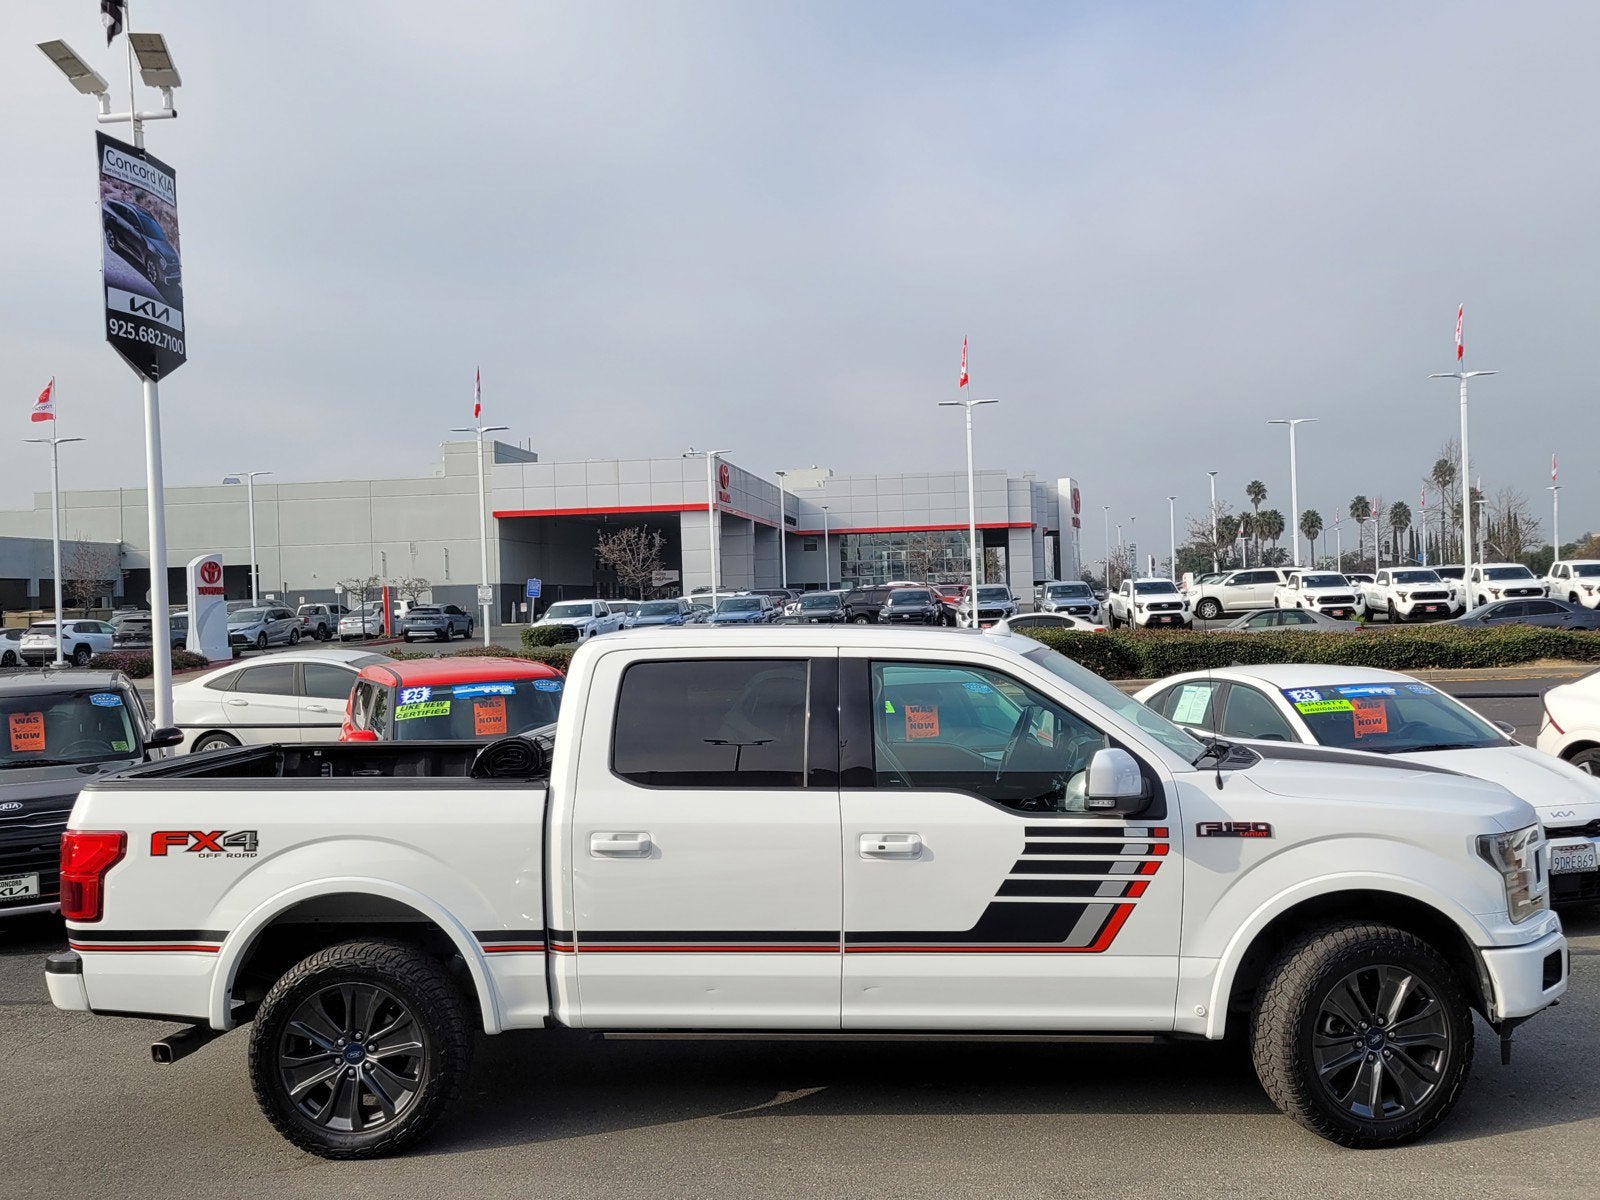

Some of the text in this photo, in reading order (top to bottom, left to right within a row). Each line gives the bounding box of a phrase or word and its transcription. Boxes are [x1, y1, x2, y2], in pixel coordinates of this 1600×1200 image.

[106, 149, 156, 184] Concord
[157, 173, 174, 196] KIA
[129, 296, 170, 323] KIA
[109, 318, 184, 355] 925.682.7100
[406, 690, 424, 701] 25
[1296, 691, 1315, 700] 23
[400, 701, 445, 712] LIKE NEW
[479, 700, 502, 708] WAS
[1300, 700, 1344, 708] SPORTY
[1357, 702, 1381, 710] WAS
[395, 708, 448, 720] CERTIFIED
[14, 716, 39, 724] WAS
[479, 716, 502, 724] NOW
[1358, 717, 1382, 726] NOW
[910, 722, 935, 730] NOW
[15, 732, 40, 740] NOW
[150, 830, 259, 856] FX4
[1554, 854, 1594, 871] 9DRE869
